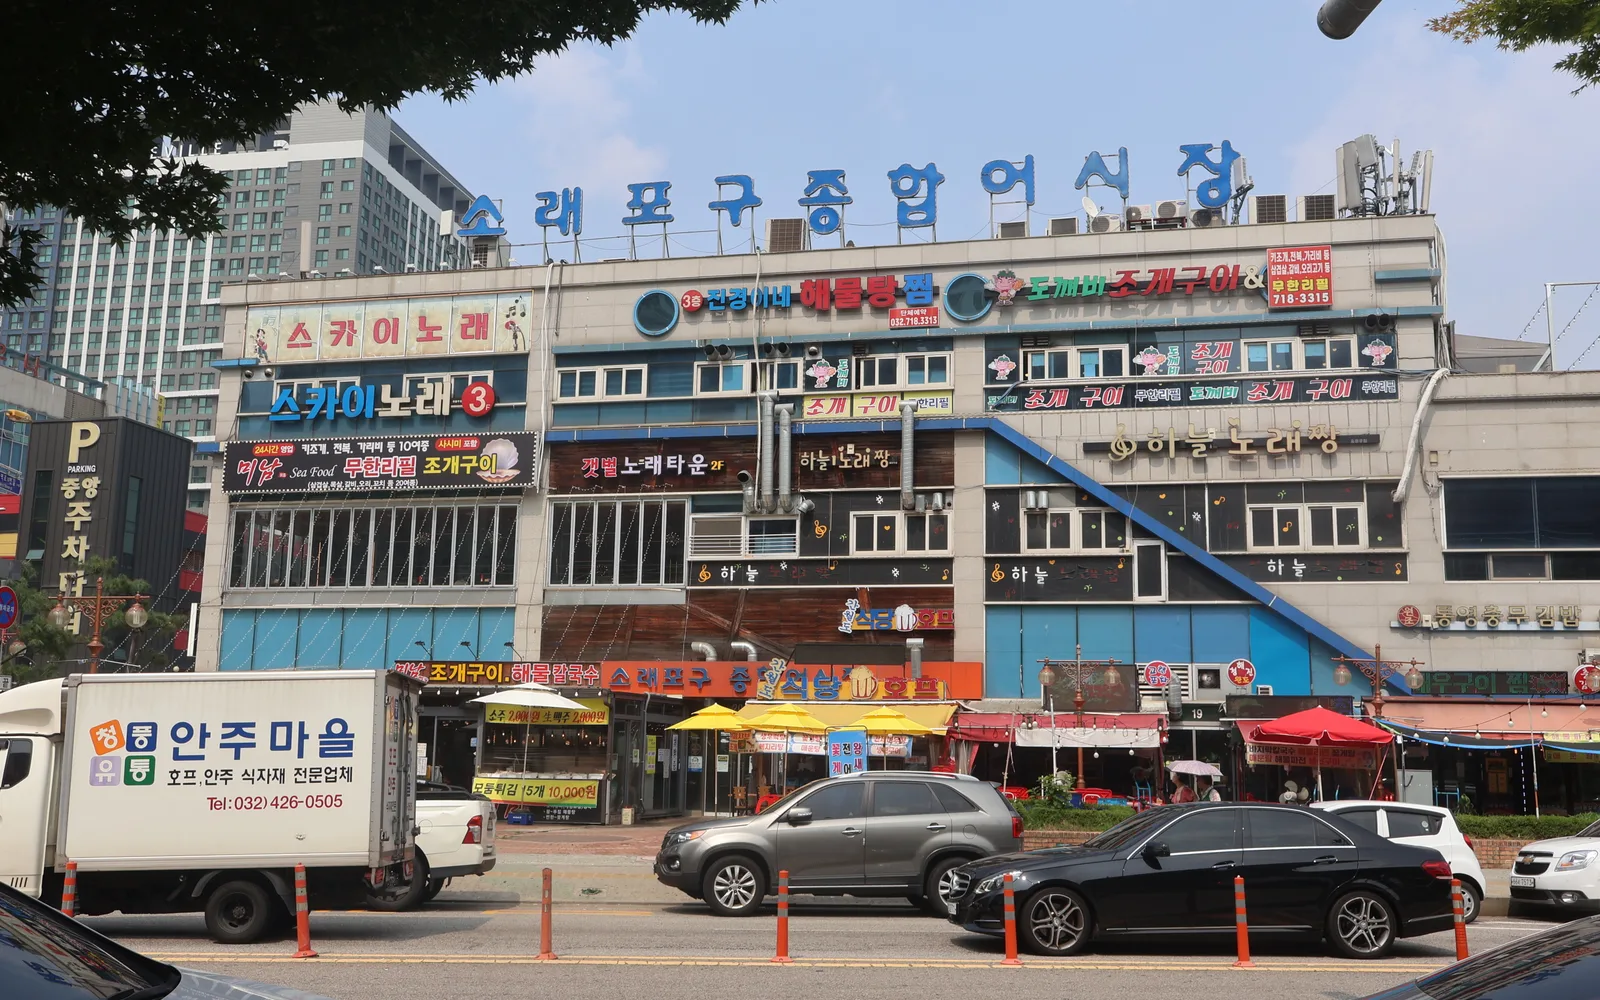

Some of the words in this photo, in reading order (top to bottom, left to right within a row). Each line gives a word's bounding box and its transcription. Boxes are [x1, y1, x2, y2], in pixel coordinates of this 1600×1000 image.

[1323, 250, 1330, 260] 등
[1324, 262, 1331, 273] 등
[1026, 275, 1105, 301] 도깨비
[1108, 264, 1241, 298] 조개구이
[1243, 264, 1266, 290] &
[1272, 278, 1329, 292] 무한리필
[682, 294, 702, 308] 3층
[707, 285, 791, 311] 진경이네
[1273, 292, 1329, 304] 718-3315
[286, 312, 490, 349] 스카이노래
[890, 316, 938, 326] 032.718.3313
[1166, 345, 1180, 375] 도깨비
[1191, 341, 1233, 360] 조개
[836, 359, 849, 388] 도깨비
[1195, 360, 1229, 374] 구이
[1025, 387, 1069, 409] 조개
[1080, 386, 1124, 408] 구이
[1135, 388, 1181, 402] 무한리필
[1189, 386, 1239, 400] 도깨비
[1247, 381, 1294, 401] 조개
[1306, 379, 1353, 401] 구이
[1362, 380, 1396, 393] 무한리필
[806, 397, 847, 416] 조개
[858, 395, 897, 414] 구이
[909, 397, 949, 409] 한리필
[68, 422, 100, 463] P
[254, 445, 278, 454] 24시간
[280, 445, 293, 453] 영업
[357, 442, 383, 453] 가리비
[387, 442, 396, 453] 등
[400, 440, 430, 452] 10여종
[438, 439, 461, 448] 사시미
[463, 439, 478, 448] 포함
[67, 465, 96, 473] PARKING
[290, 467, 307, 479] Sea
[310, 465, 338, 478] Food
[343, 455, 417, 478] 무한리필
[423, 453, 497, 475] 조개구이
[582, 457, 617, 479] 갯벌
[620, 453, 709, 476] 노래타운
[710, 460, 725, 471] 2F
[61, 477, 101, 499] 중앙
[1011, 566, 1048, 584] 하늘
[1267, 558, 1306, 577] 하늘
[856, 609, 897, 630] 식당
[917, 608, 955, 629] 호프
[1435, 604, 1582, 628] 통영충무김밥
[609, 667, 711, 690] 소래포구
[781, 675, 842, 700] 식당
[882, 676, 938, 699] 호프
[489, 710, 506, 722] 소주
[1192, 708, 1203, 719] 19
[169, 718, 356, 762] 안주마을
[167, 767, 234, 788] 호프,안주
[241, 768, 286, 785] 식자재
[294, 766, 353, 784] 전문업체
[473, 783, 518, 796] 모둠튀김
[548, 785, 596, 800] 10,000원
